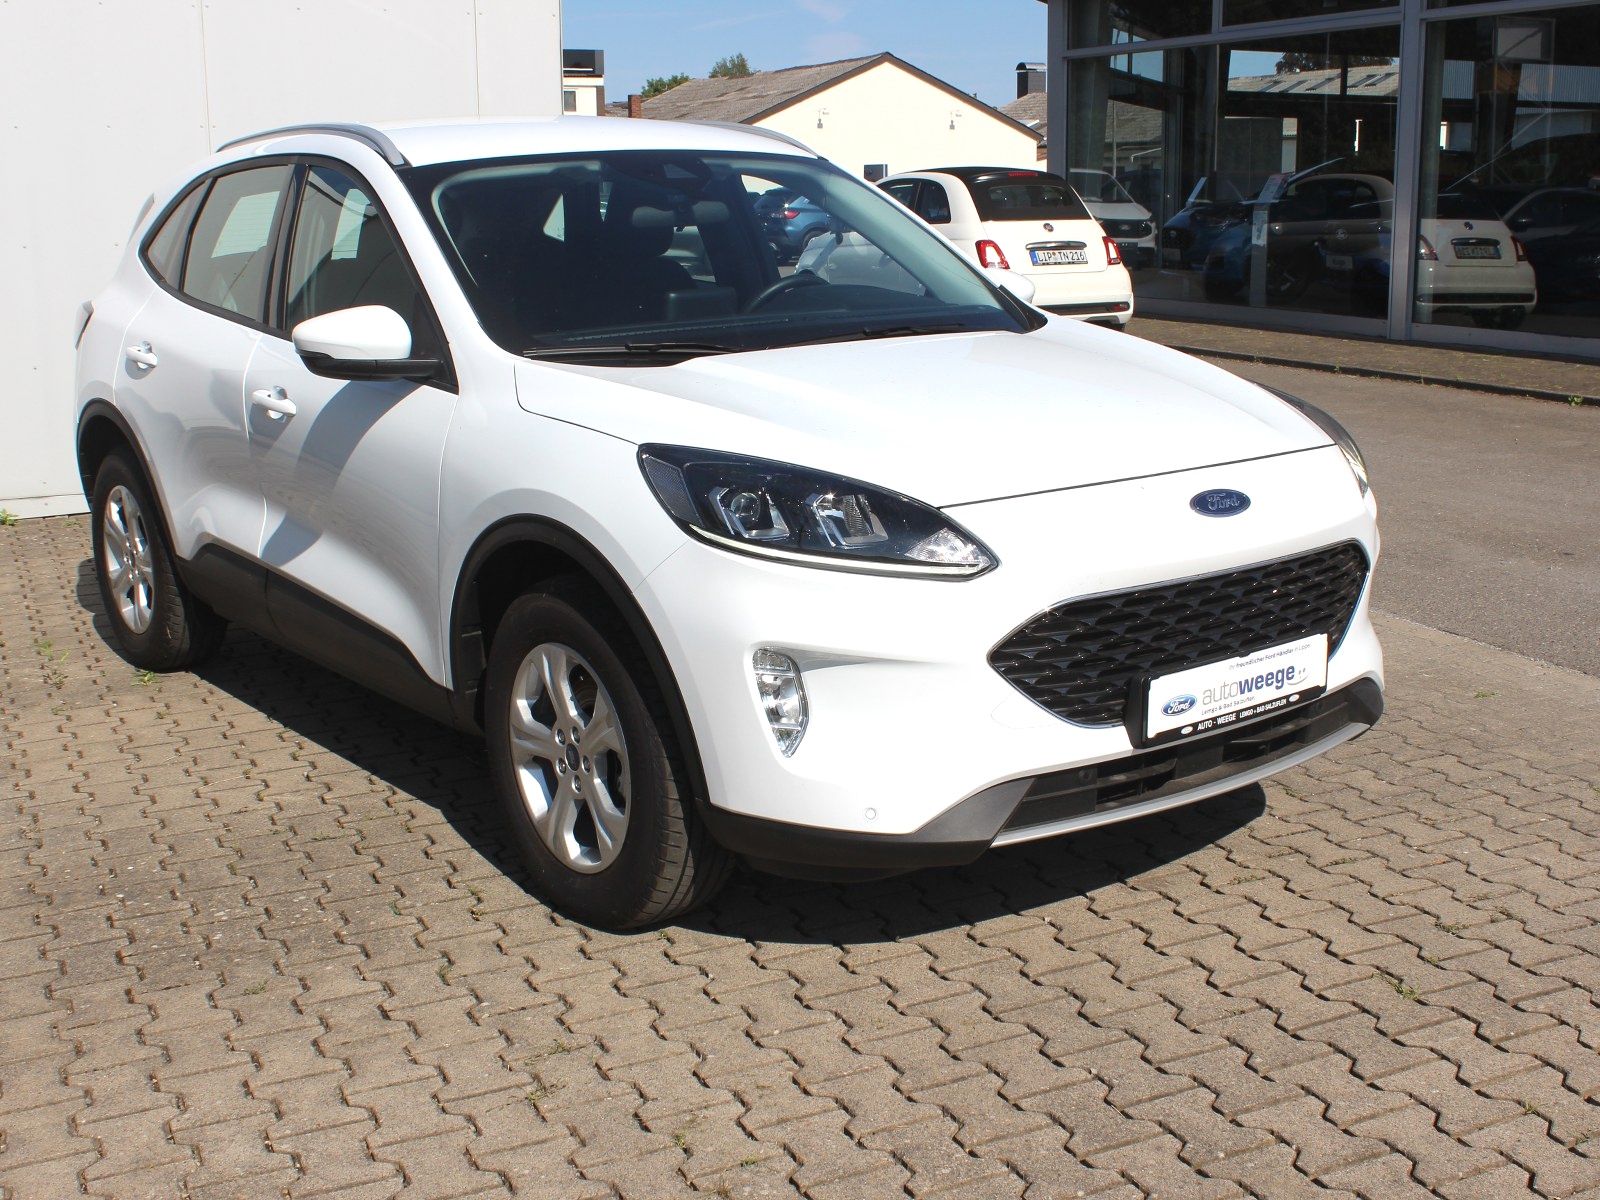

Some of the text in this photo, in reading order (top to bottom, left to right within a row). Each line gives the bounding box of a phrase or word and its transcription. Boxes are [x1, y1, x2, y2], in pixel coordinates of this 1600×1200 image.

[1036, 251, 1085, 262] LIP TN 216
[1207, 492, 1240, 511] Ford
[1202, 665, 1295, 705] autoweege
[1167, 699, 1191, 714] Ford
[1201, 707, 1218, 716] Lemgo
[1197, 719, 1213, 731] AUTO
[1217, 713, 1237, 725] WEEGE
[1239, 708, 1254, 718] LEMGO
[1256, 705, 1265, 713] BAD
